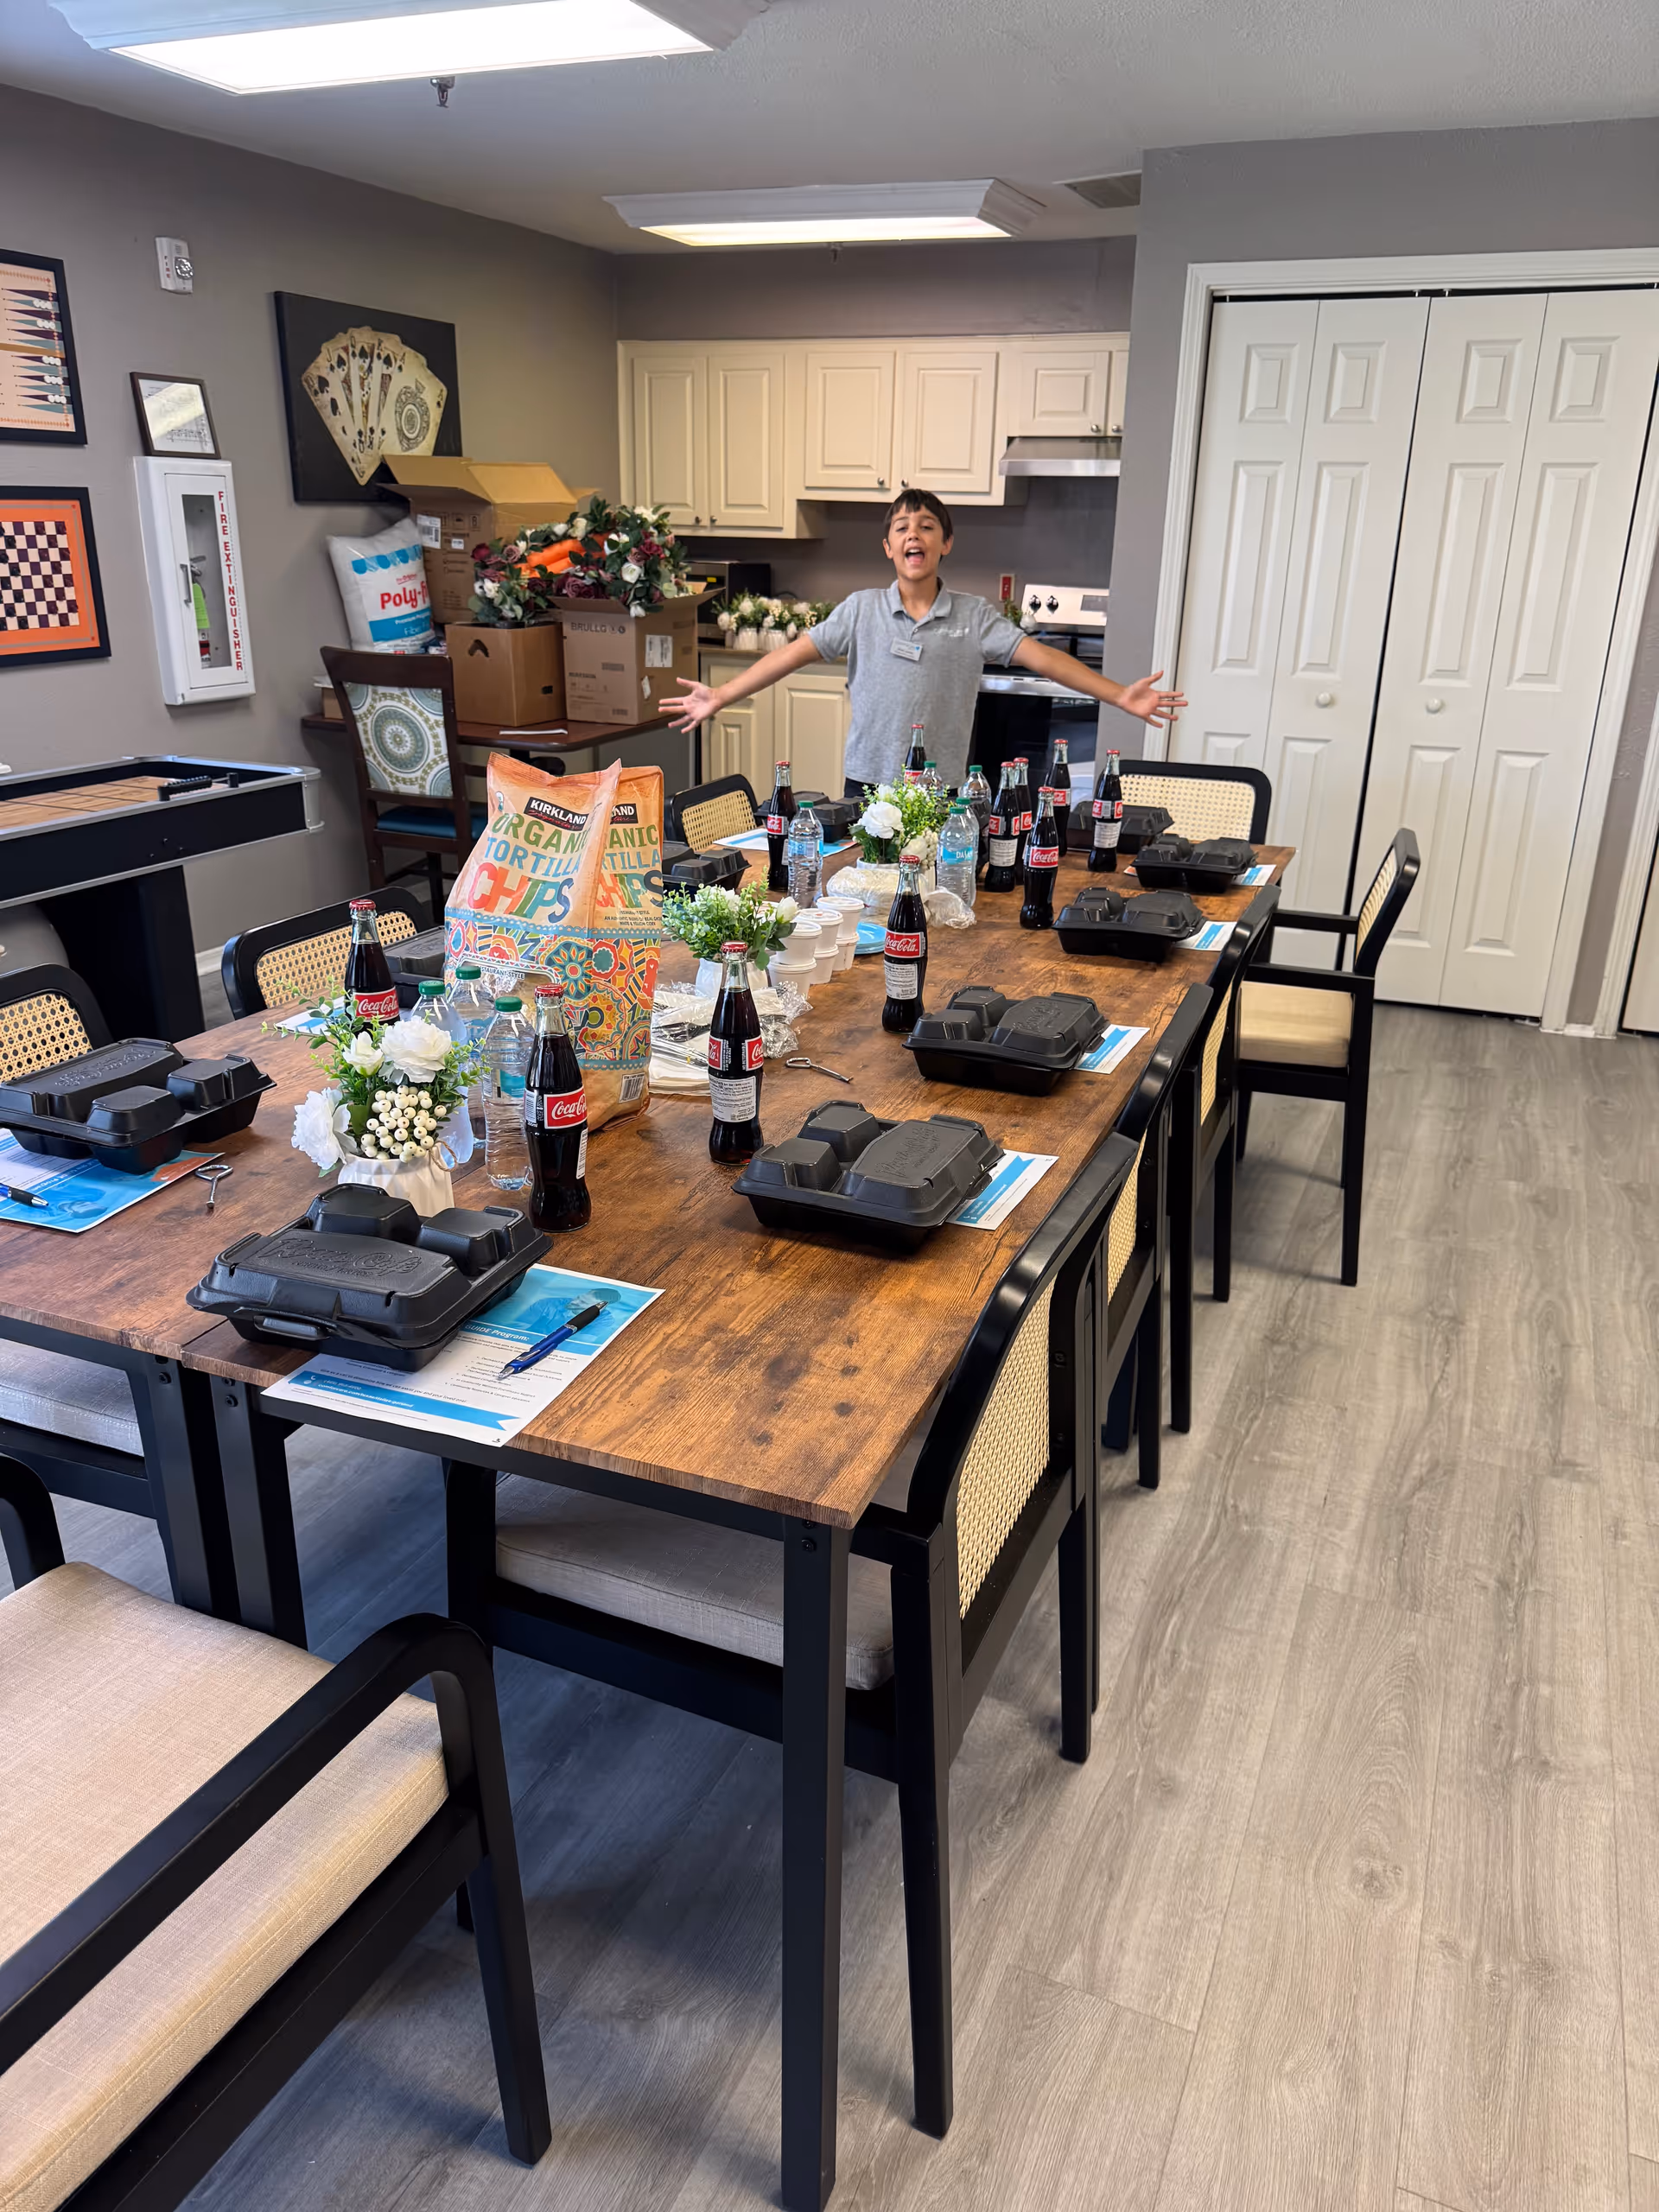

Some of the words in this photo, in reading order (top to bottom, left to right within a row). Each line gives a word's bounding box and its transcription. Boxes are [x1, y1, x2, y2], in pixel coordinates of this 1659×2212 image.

[218, 491, 228, 536] FIRE
[224, 542, 244, 671] EXTINGUISHER
[530, 799, 587, 825] KIRKLAND
[467, 862, 575, 924] CHIPS
[885, 935, 918, 952] Coca-Cola
[464, 1325, 493, 1333] GUIDE
[492, 1329, 530, 1342] Program:
